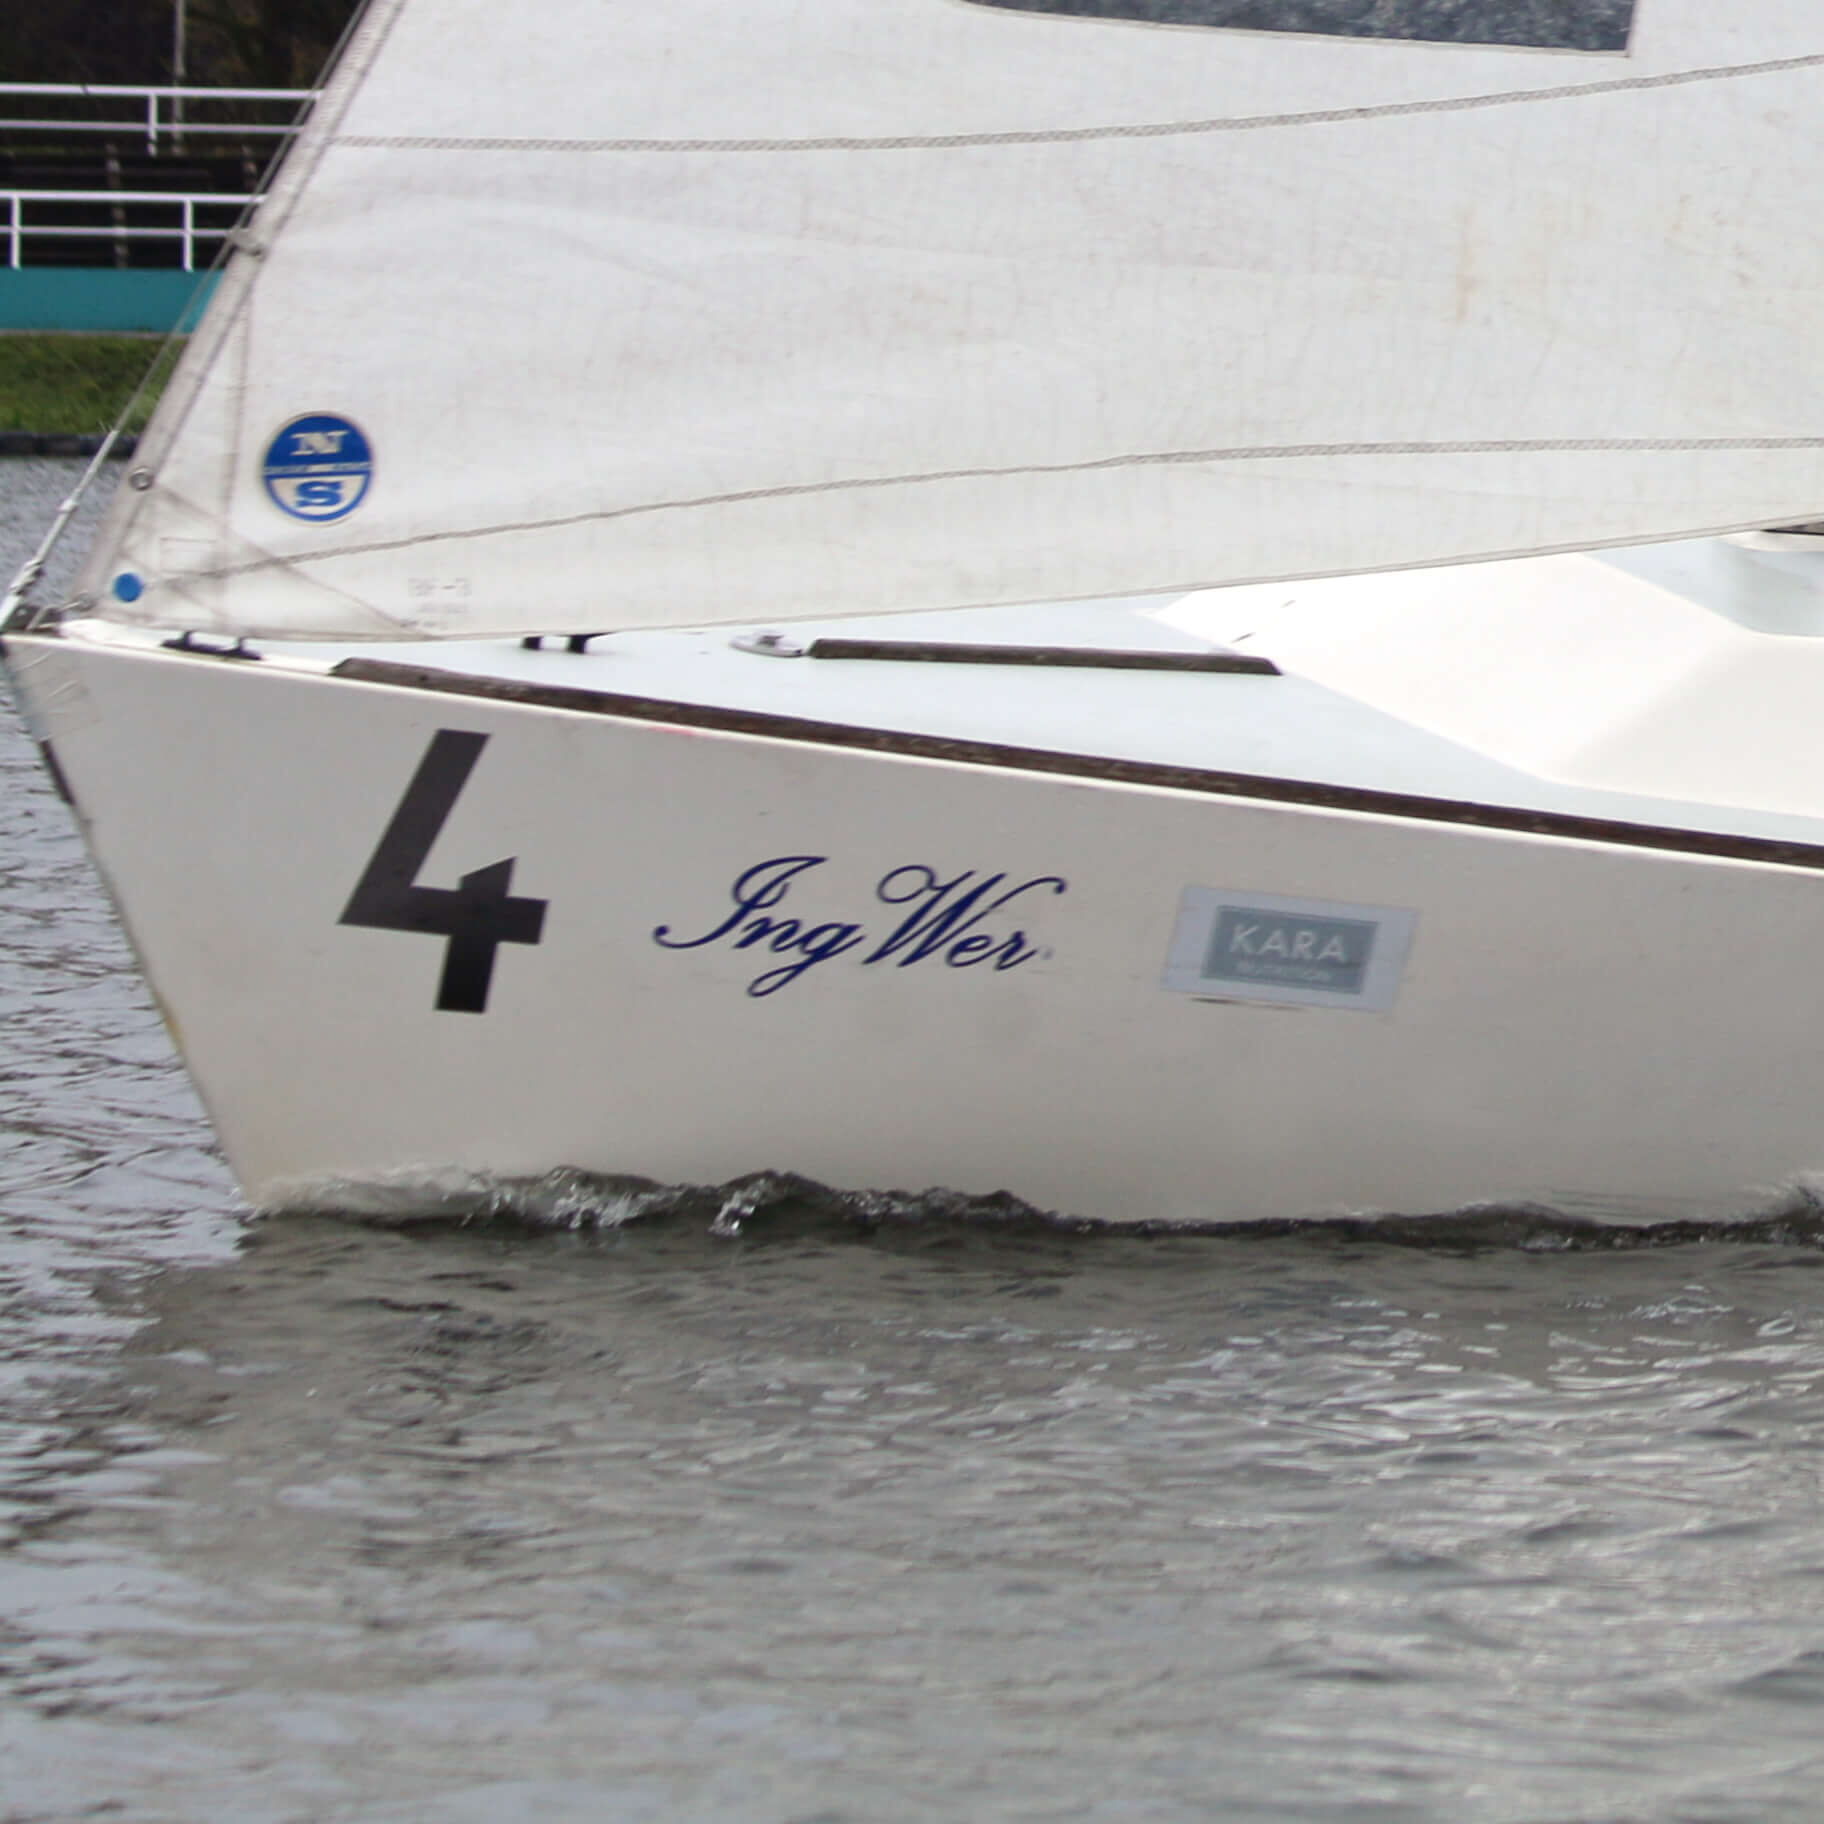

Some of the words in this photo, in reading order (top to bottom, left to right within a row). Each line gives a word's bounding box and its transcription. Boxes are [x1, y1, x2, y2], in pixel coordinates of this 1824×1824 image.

[290, 429, 349, 456] N
[295, 480, 344, 508] S
[337, 729, 549, 1014] 4
[1229, 924, 1348, 963] KARA
